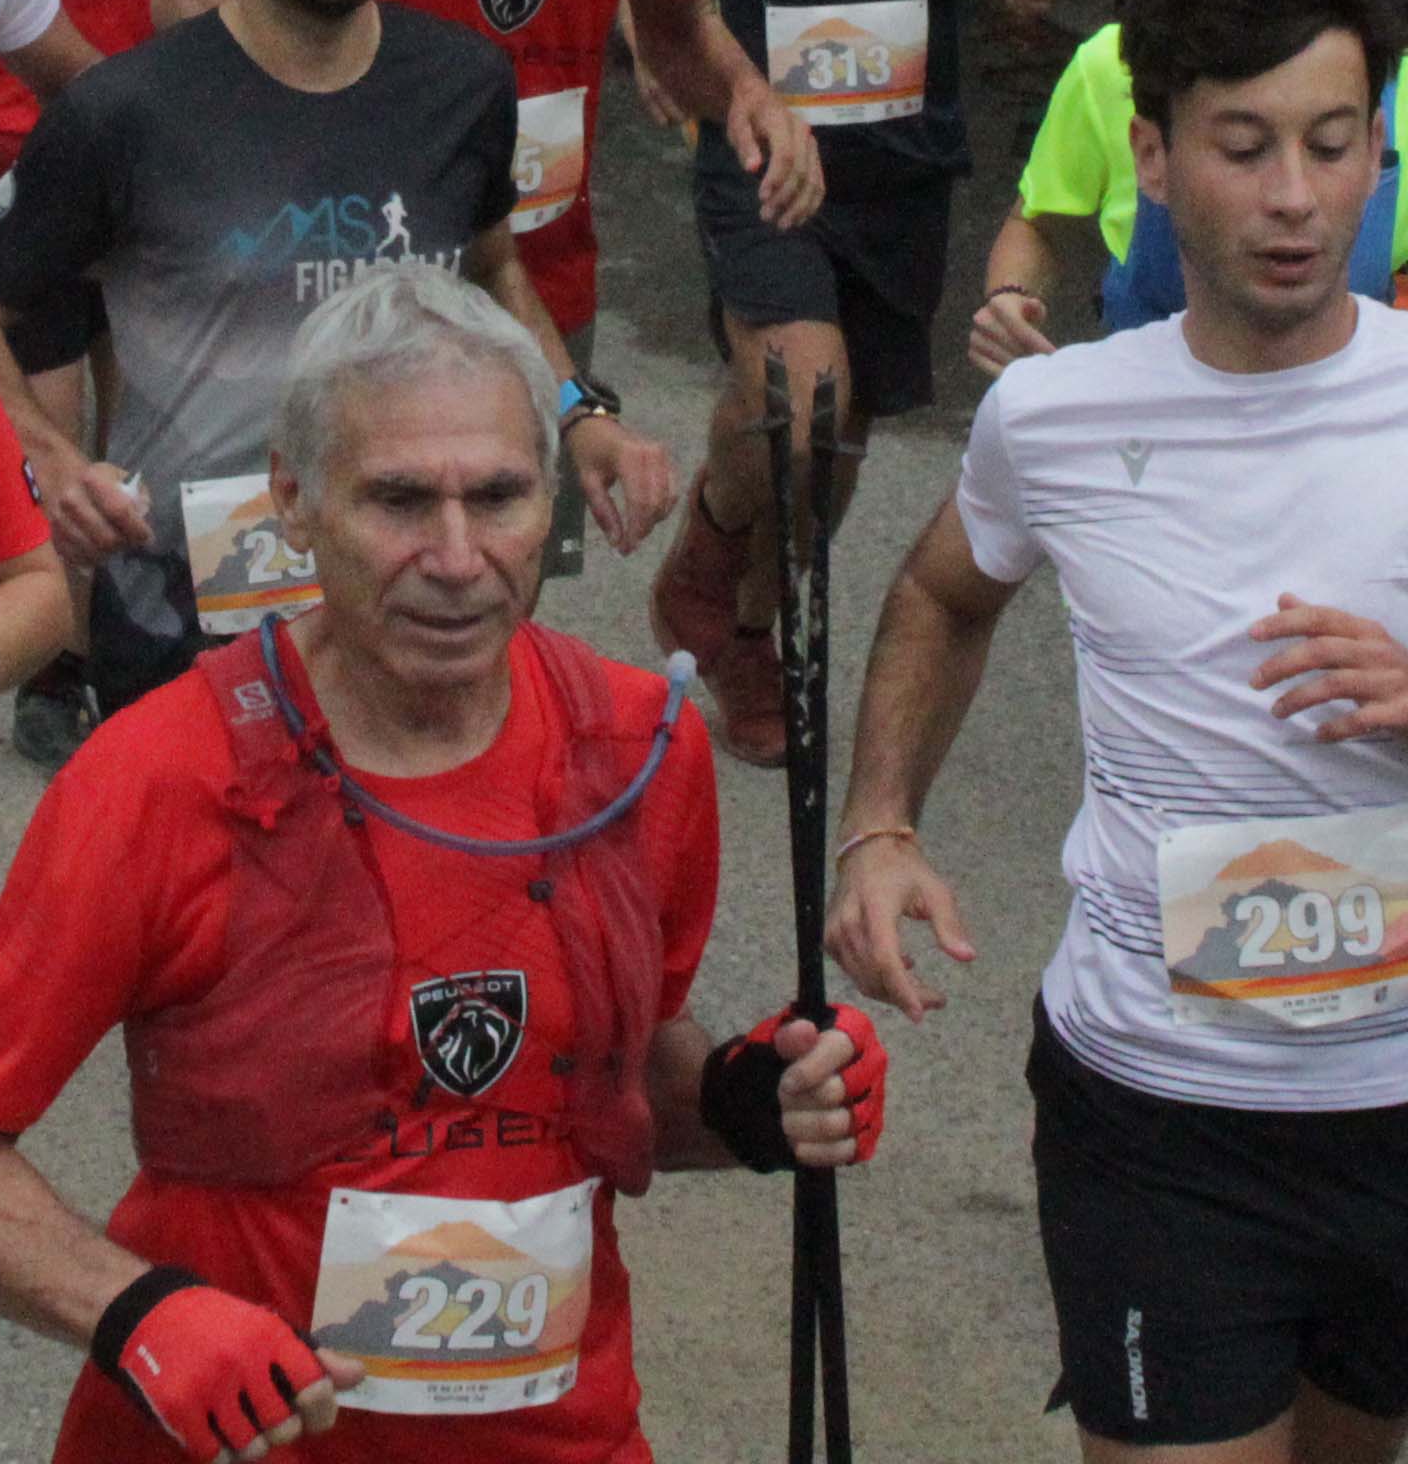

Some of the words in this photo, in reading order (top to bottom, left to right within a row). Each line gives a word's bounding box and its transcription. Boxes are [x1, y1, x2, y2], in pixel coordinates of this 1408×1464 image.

[807, 44, 893, 90] 313
[243, 530, 318, 585] 29
[1234, 884, 1386, 969] 299
[390, 1273, 549, 1350] 229
